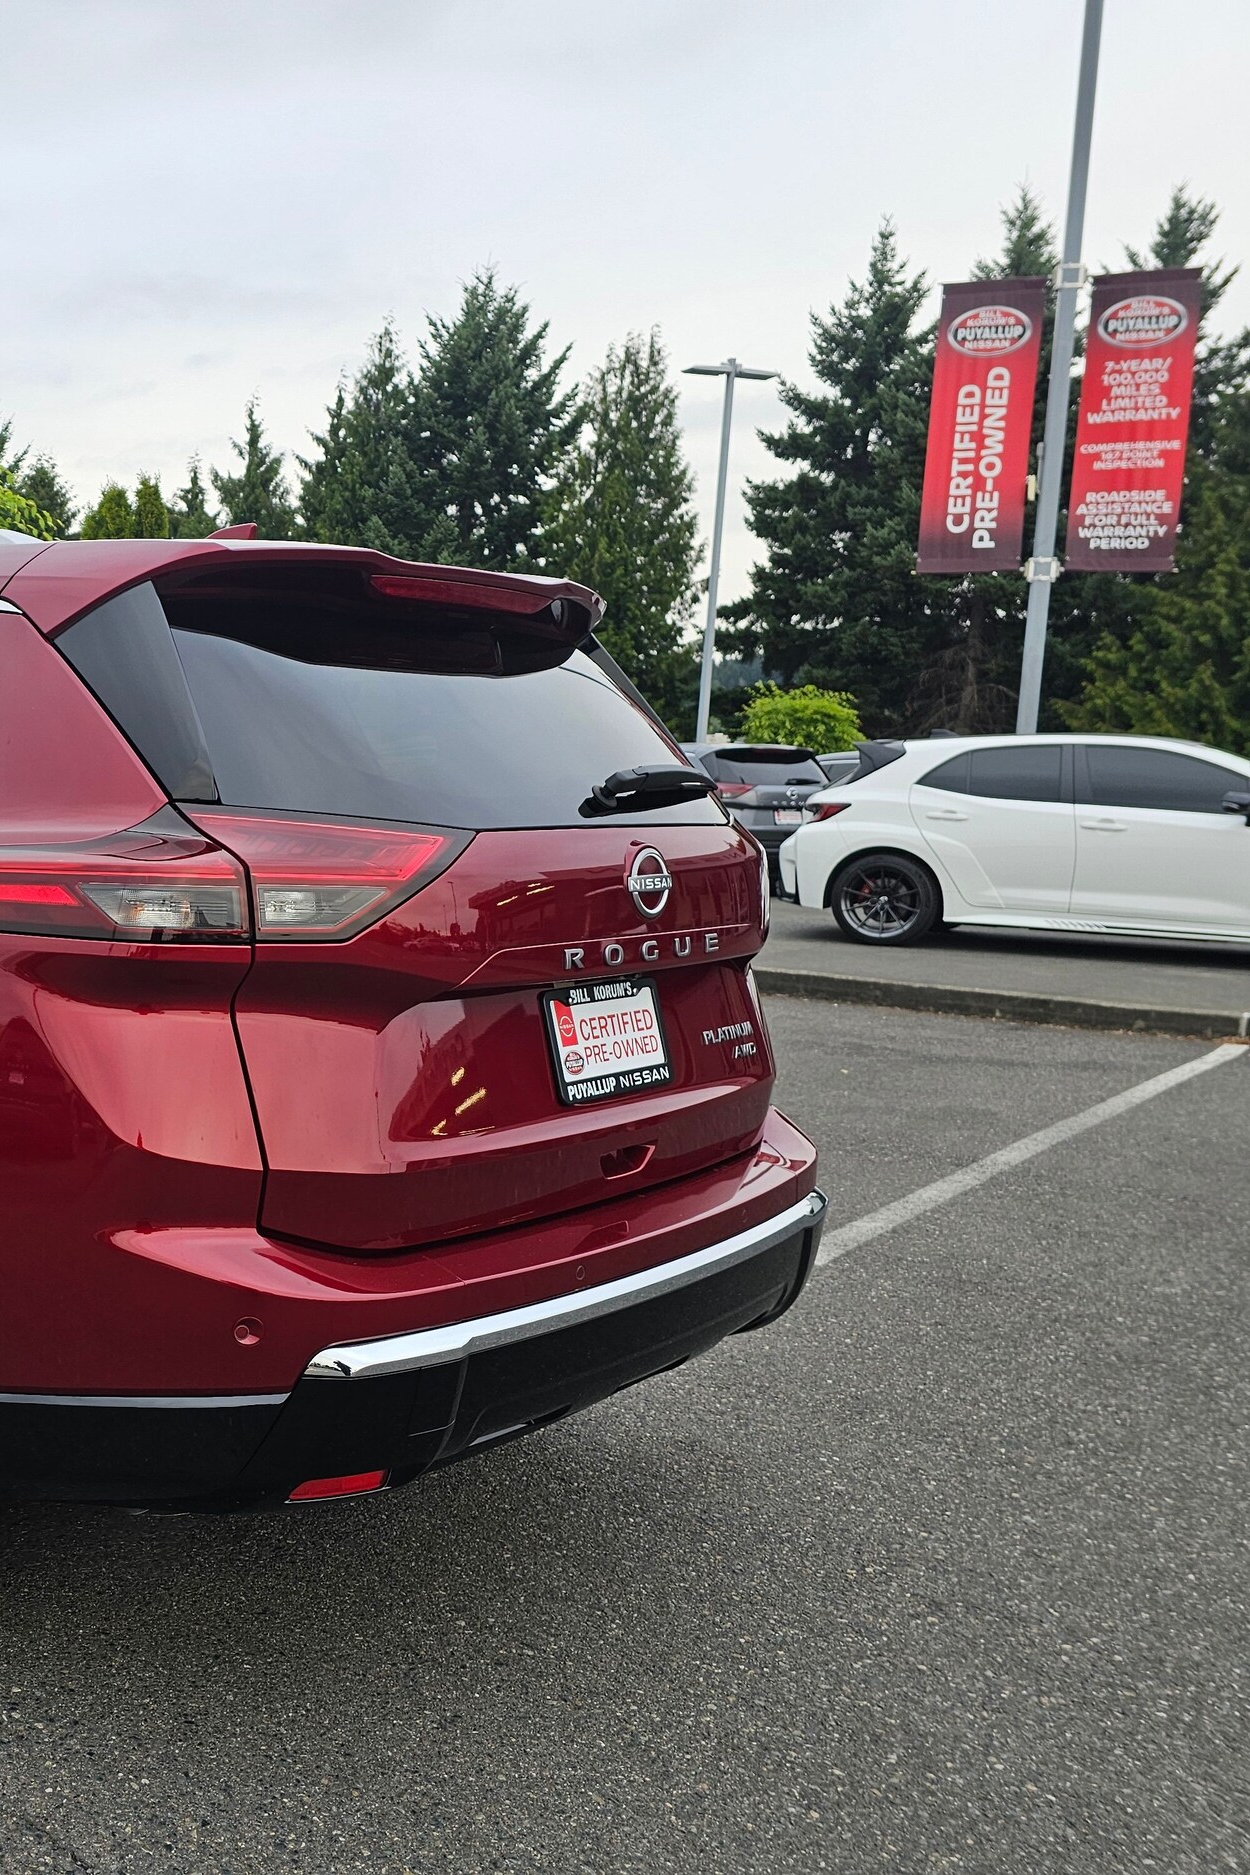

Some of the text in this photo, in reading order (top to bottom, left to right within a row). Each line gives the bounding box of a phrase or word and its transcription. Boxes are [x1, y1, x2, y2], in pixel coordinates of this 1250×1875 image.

[966, 316, 1016, 327] KORUM'S
[979, 310, 1002, 318] BILL
[1108, 315, 1179, 333] PUYALLUP
[957, 325, 1024, 341] PUYALLUP
[964, 338, 1010, 350] NISSAN
[1104, 356, 1173, 373] 7-YEAR/
[1102, 370, 1169, 386] 100,000
[1111, 383, 1161, 397] MILES
[1101, 395, 1168, 411] LIMITED
[1087, 406, 1181, 424] WARRANTY
[1080, 440, 1182, 454] COMPREHENSIVE
[1123, 449, 1160, 459] POINT
[946, 384, 981, 534] CERTIFIED
[972, 366, 1011, 549] PRE-OWNED
[1093, 458, 1165, 471] INSPECTION
[1086, 489, 1167, 503] ROADSIDE
[1076, 501, 1173, 515] ASSISTANCE
[1084, 513, 1159, 526] FOR FULL
[1078, 525, 1168, 538] WARRANTY
[1089, 537, 1150, 549] PERIOD
[629, 874, 672, 891] NISSAN
[564, 933, 719, 970] ROGUE
[570, 982, 632, 1004] BILL KORUM'S
[579, 1009, 653, 1041] CERTIFIED
[702, 1021, 753, 1045] PLATINUM
[584, 1034, 659, 1065] PRE-OWNED
[734, 1042, 756, 1059] AWD
[567, 1066, 670, 1101] PUYALLUP NISSAN
